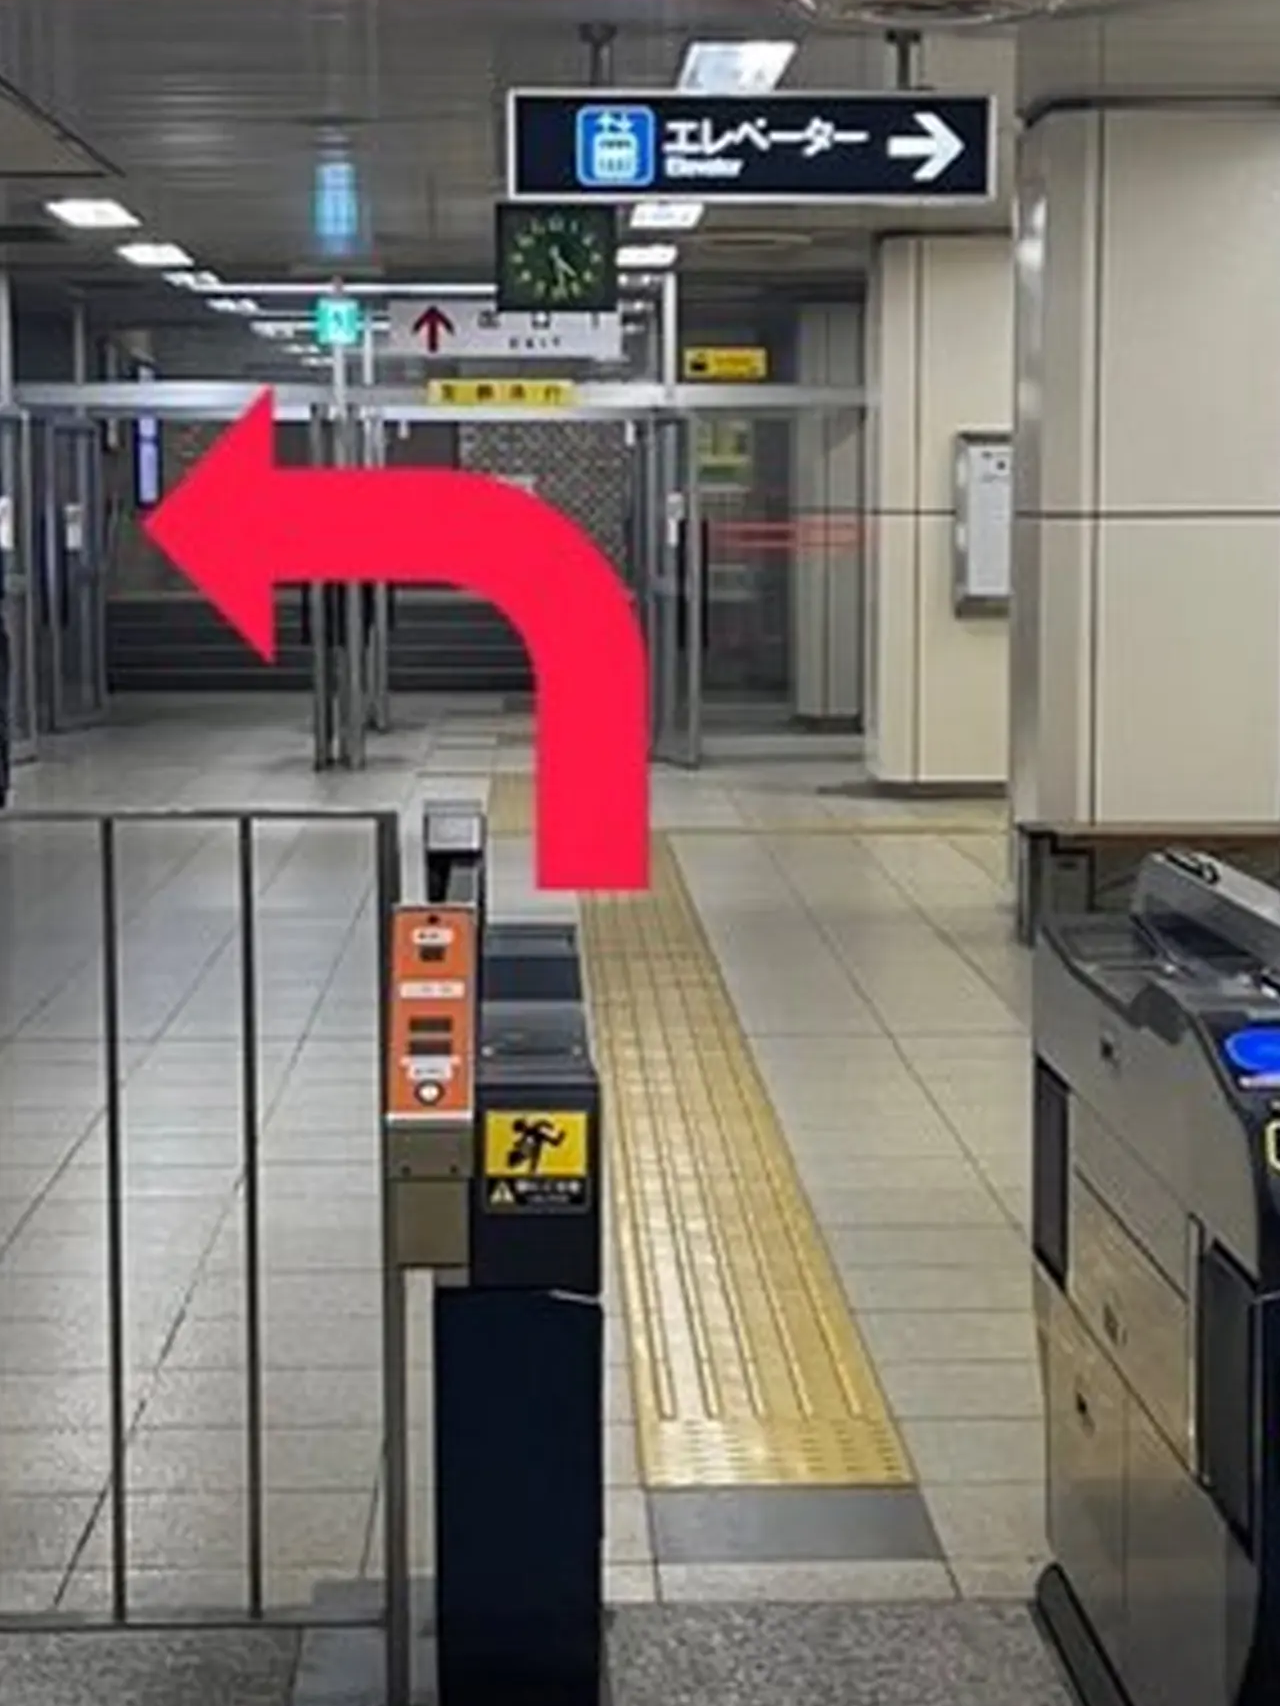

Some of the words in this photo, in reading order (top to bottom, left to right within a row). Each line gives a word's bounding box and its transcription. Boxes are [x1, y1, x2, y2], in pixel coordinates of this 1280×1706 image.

[662, 116, 870, 159] エレベーター
